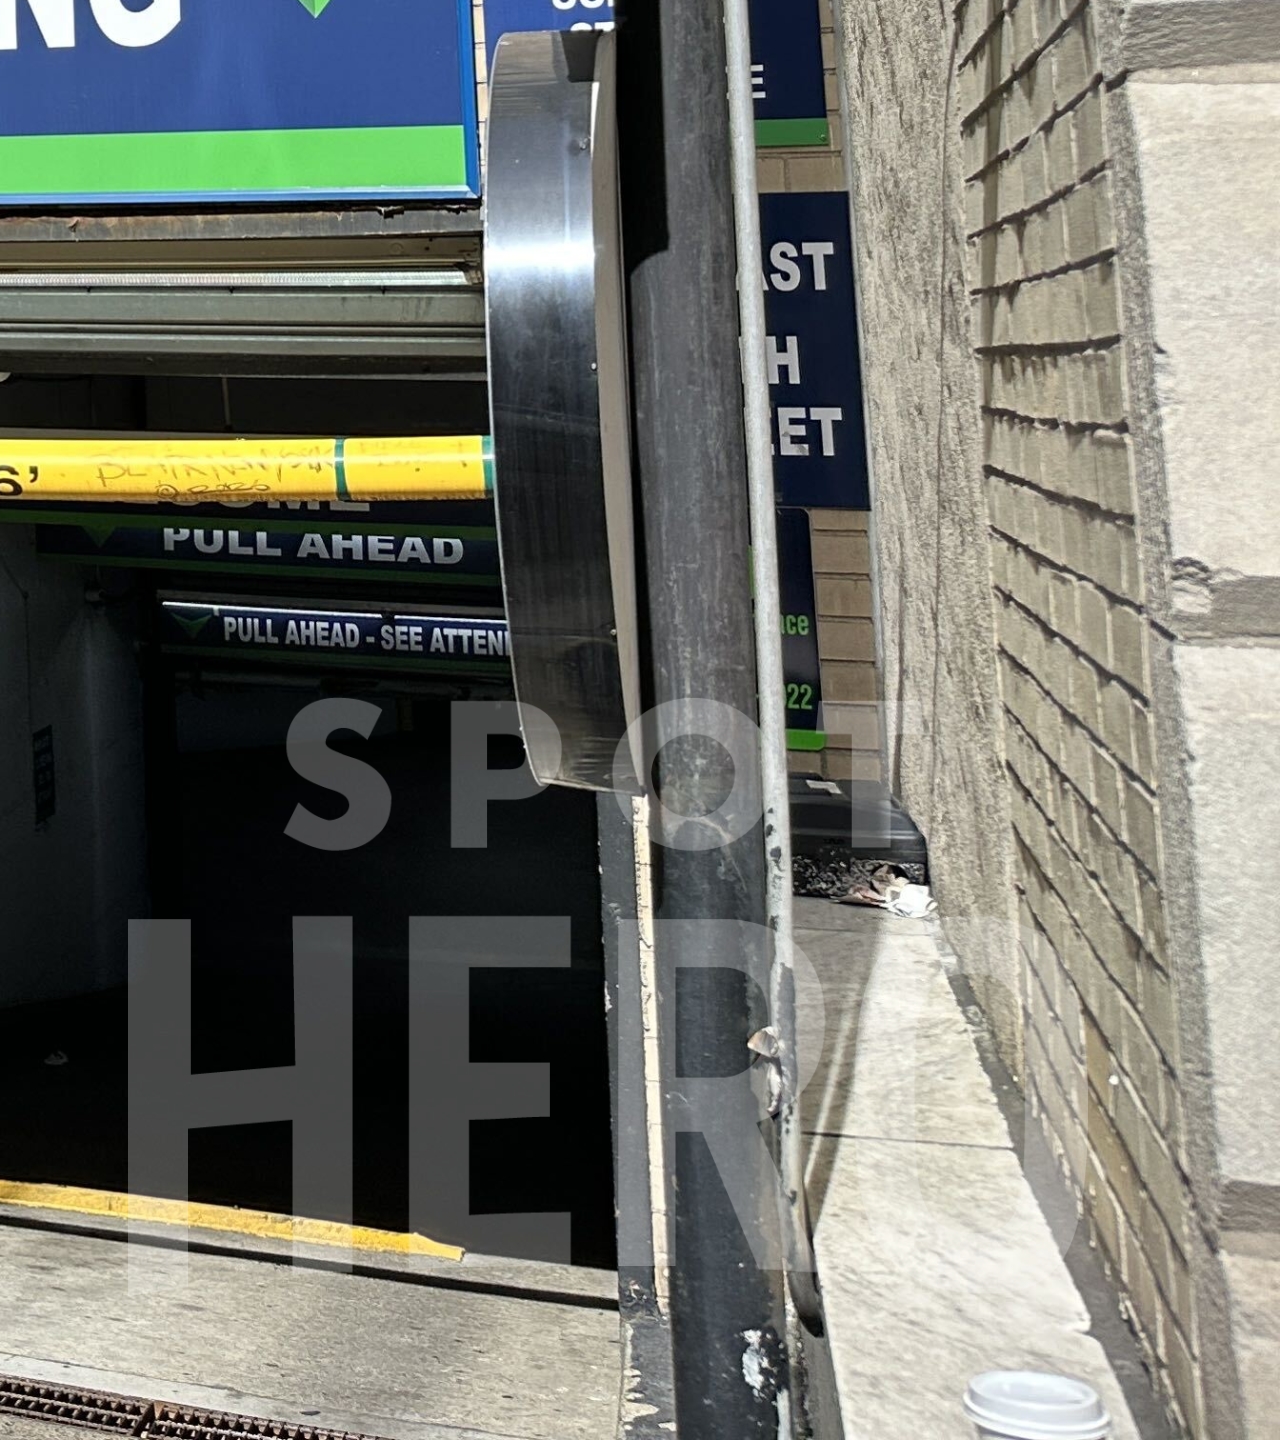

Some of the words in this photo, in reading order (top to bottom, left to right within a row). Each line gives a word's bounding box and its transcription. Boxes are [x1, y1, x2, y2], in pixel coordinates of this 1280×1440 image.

[163, 527, 282, 557] PULL
[297, 533, 465, 566] AHEAD
[224, 616, 280, 644] PULL
[285, 620, 360, 649] AHEAD
[381, 625, 423, 652] SEE
